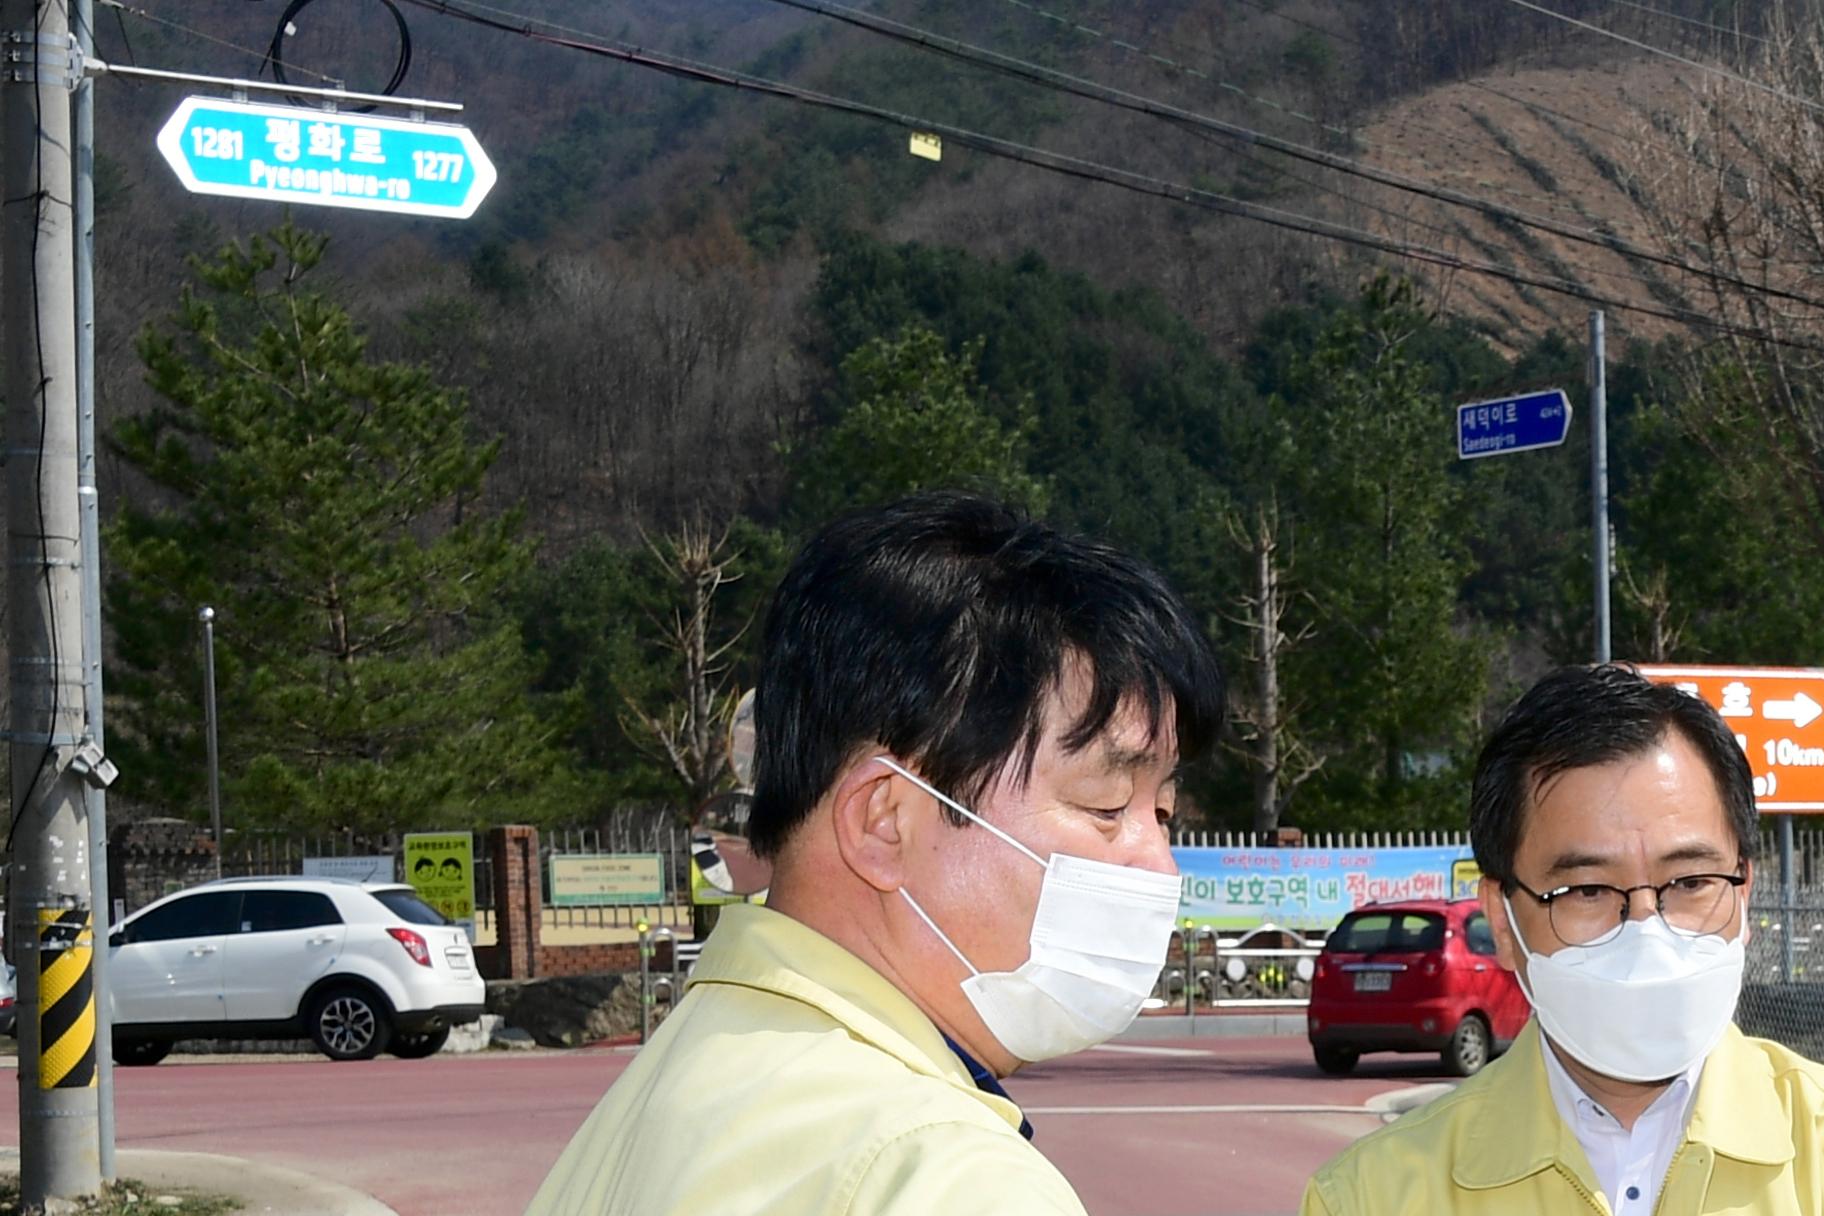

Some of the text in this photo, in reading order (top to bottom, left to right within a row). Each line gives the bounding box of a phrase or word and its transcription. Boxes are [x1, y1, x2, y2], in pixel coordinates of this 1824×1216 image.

[191, 127, 243, 160] 1281
[266, 118, 386, 164] 평화로
[250, 159, 411, 200] Pyeonghwa-ro
[412, 151, 464, 183] 1277
[1463, 403, 1518, 430] 새덕이로
[1763, 738, 1824, 766] 10km
[1180, 876, 1215, 906] 린이
[1226, 875, 1308, 907] 보호구역
[1317, 879, 1338, 902] 내
